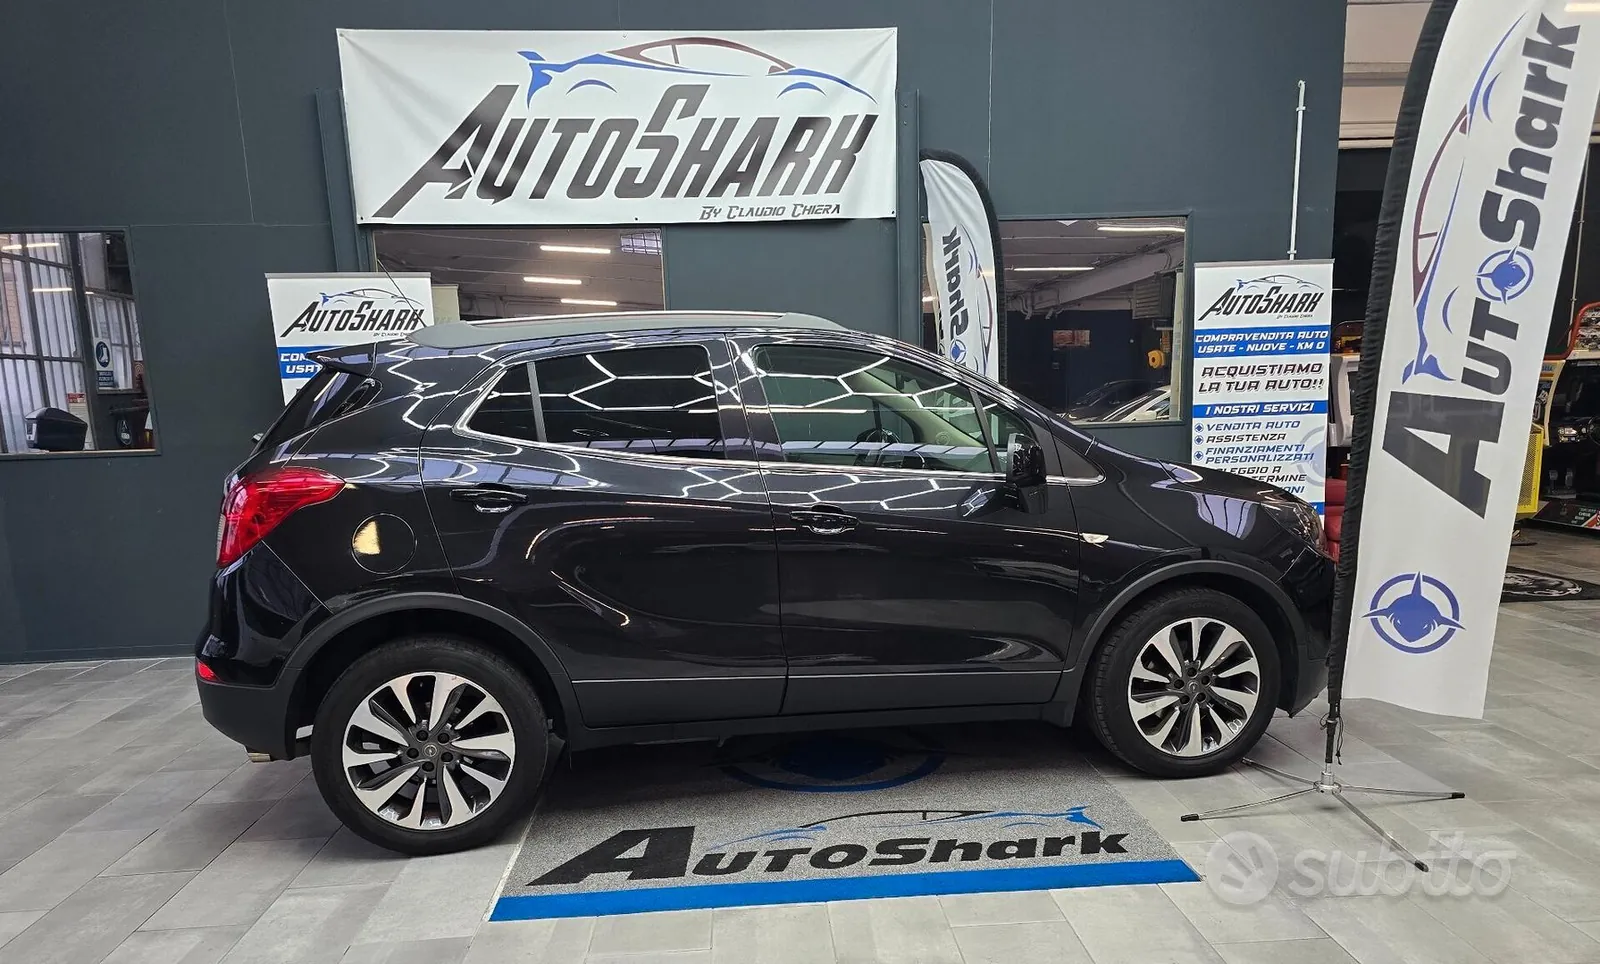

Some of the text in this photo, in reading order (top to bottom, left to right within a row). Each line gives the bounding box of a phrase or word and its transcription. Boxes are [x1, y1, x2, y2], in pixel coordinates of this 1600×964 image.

[699, 203, 841, 220] BY CLAUDIO CHIERA
[1195, 330, 1328, 343] COMPRAVENDITA AUTO
[1198, 344, 1236, 353] USATE
[1246, 342, 1287, 351] NUOVE
[1296, 341, 1314, 350] KM
[1201, 363, 1323, 377] ACQUISTIAMO
[1198, 378, 1324, 393] LA TUA AUTO!!
[1205, 402, 1314, 415] I NOSTRI SERVIZI
[1206, 420, 1301, 431] VENDITA AUTO
[1206, 433, 1287, 443] ASSISTENZA
[1205, 444, 1305, 455] FINANZIAMENTI
[1205, 452, 1315, 464] PERSONALIZZATI
[1217, 465, 1282, 475] EGGIO A
